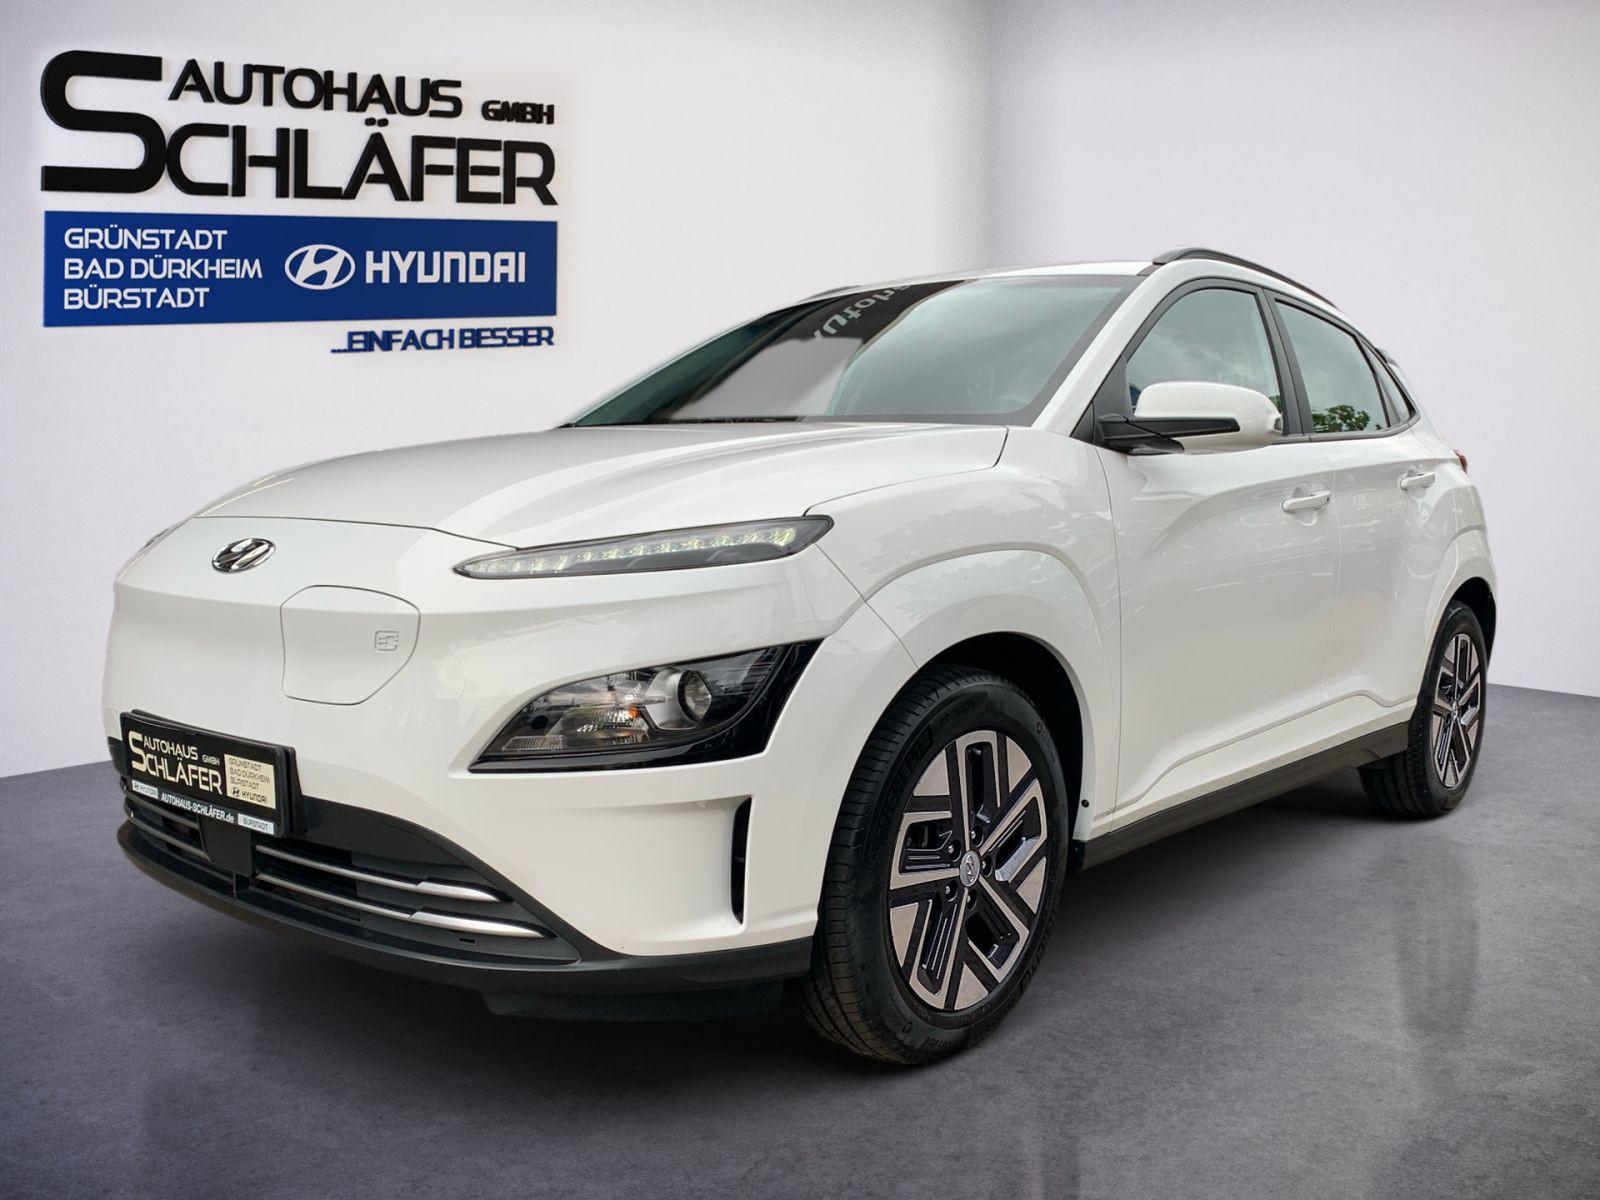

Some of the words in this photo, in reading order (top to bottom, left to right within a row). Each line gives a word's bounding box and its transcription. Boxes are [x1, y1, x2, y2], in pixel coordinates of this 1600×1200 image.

[168, 59, 462, 118] AUTOHAUS
[481, 100, 555, 125] GMBH
[40, 50, 558, 206] SCHLÄFER
[64, 224, 228, 250] GRÜNSTADT
[64, 258, 125, 279] BAD
[130, 254, 263, 279] DÜRKHEIM
[365, 250, 526, 284] HYUNDAI
[64, 284, 210, 310] BÜRSTADT
[458, 326, 554, 349] BESSER
[143, 735, 199, 761] AUTOHAUS
[128, 730, 223, 795] SCHLÄFER
